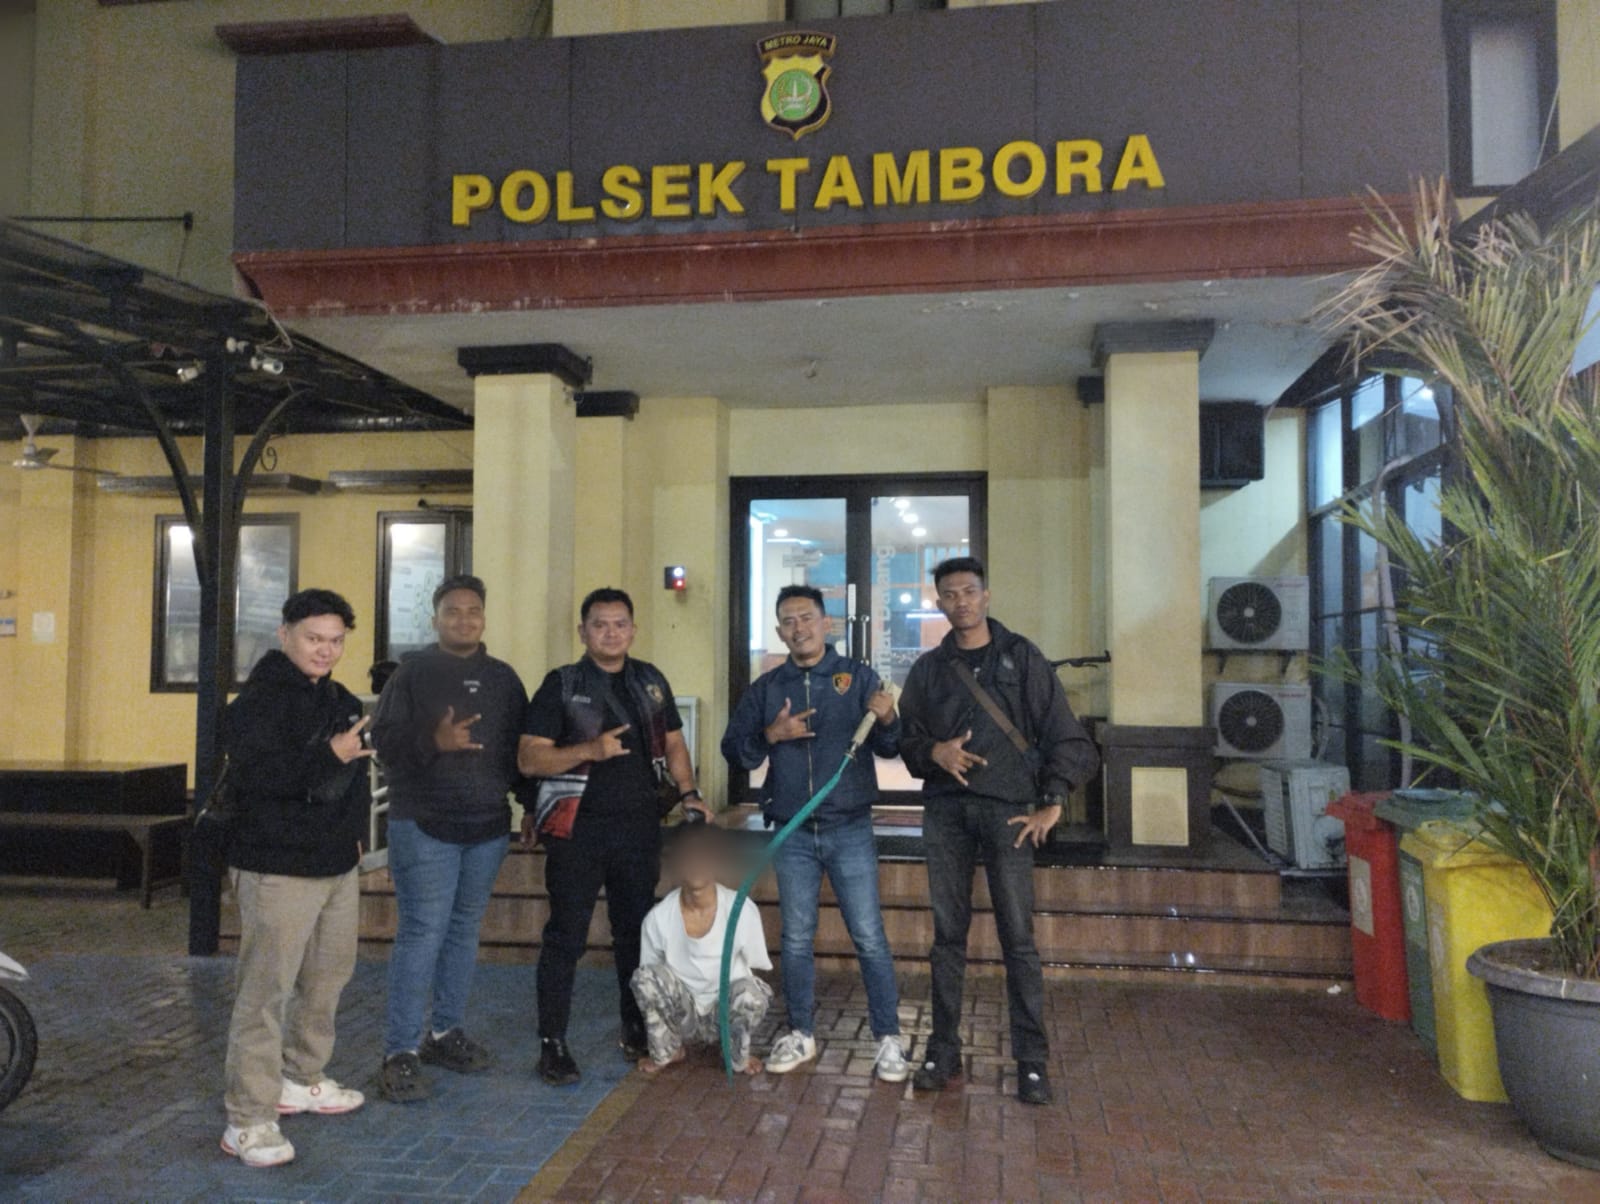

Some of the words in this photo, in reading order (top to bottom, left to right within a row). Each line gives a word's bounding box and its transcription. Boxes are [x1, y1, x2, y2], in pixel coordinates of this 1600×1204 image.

[764, 35, 801, 51] METRO
[803, 35, 828, 49] JAYA
[451, 161, 746, 227] POLSEK
[766, 134, 1166, 211] TAMBORA
